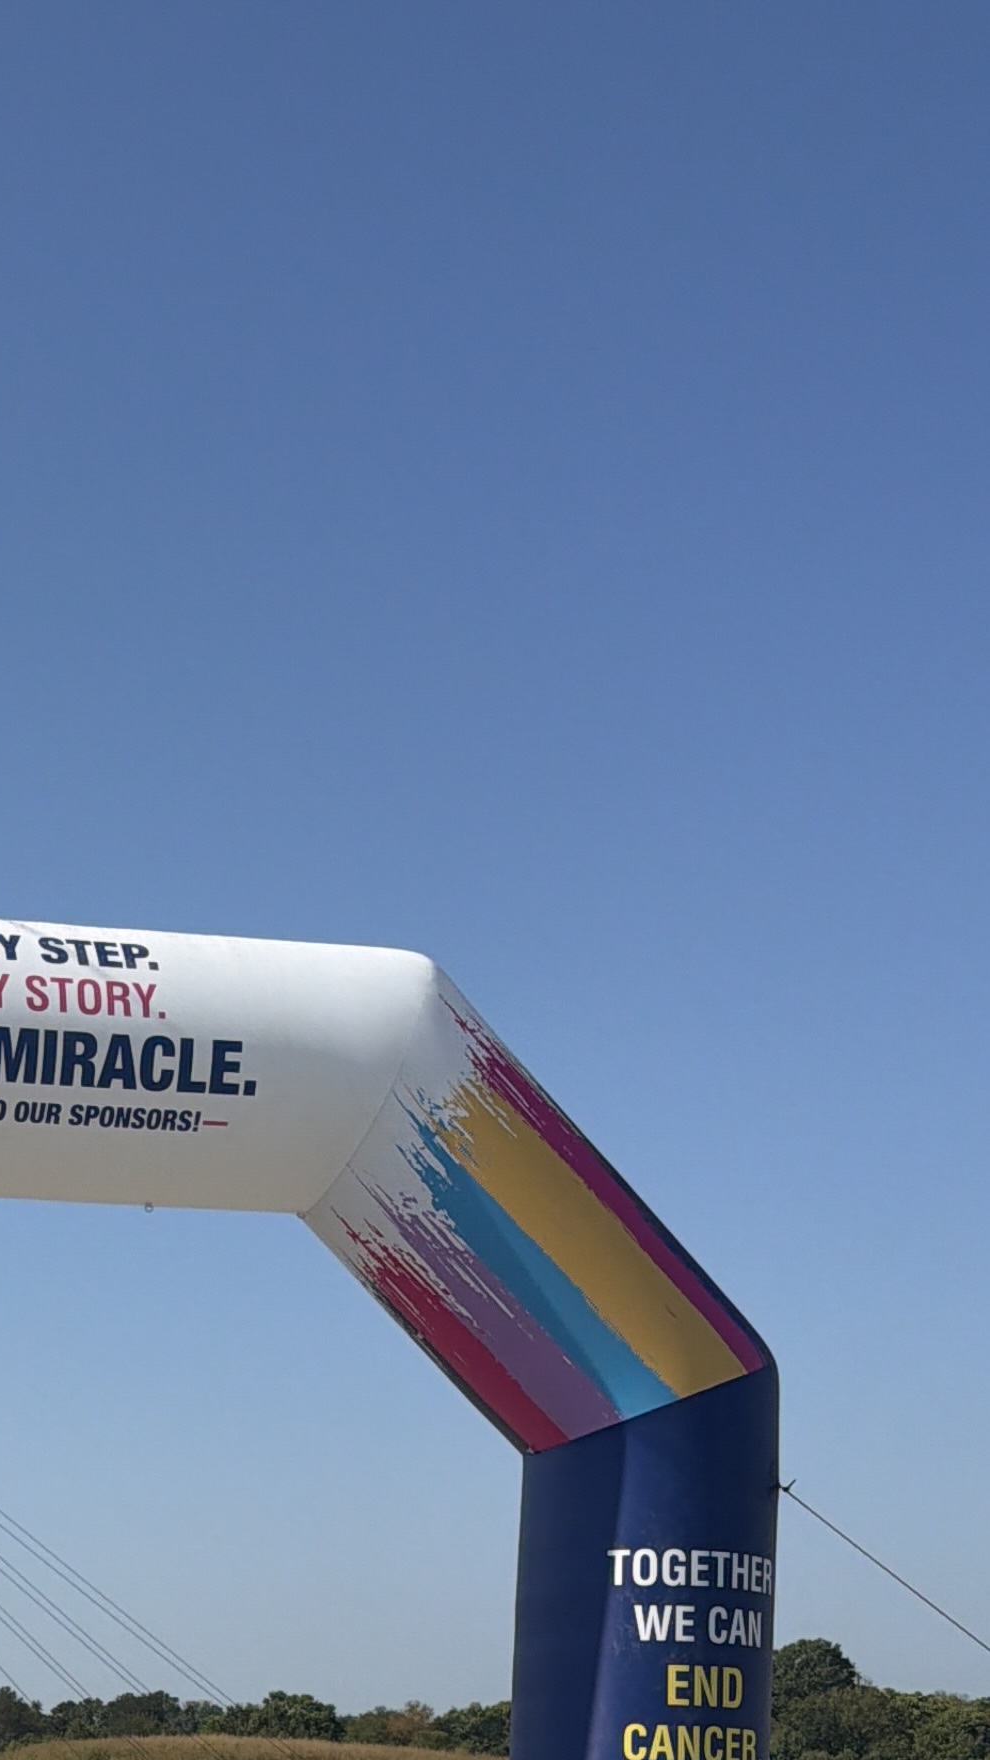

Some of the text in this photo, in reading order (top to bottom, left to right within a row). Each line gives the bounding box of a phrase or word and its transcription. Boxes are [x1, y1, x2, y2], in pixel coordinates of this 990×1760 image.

[38, 936, 160, 971] STEP.
[25, 973, 167, 1020] STORY.
[14, 1101, 61, 1126] OUR
[68, 1104, 201, 1133] SPONSORS!
[607, 1548, 772, 1596] TOGETHER
[633, 1604, 762, 1648] WE CAN
[666, 1664, 743, 1708] END
